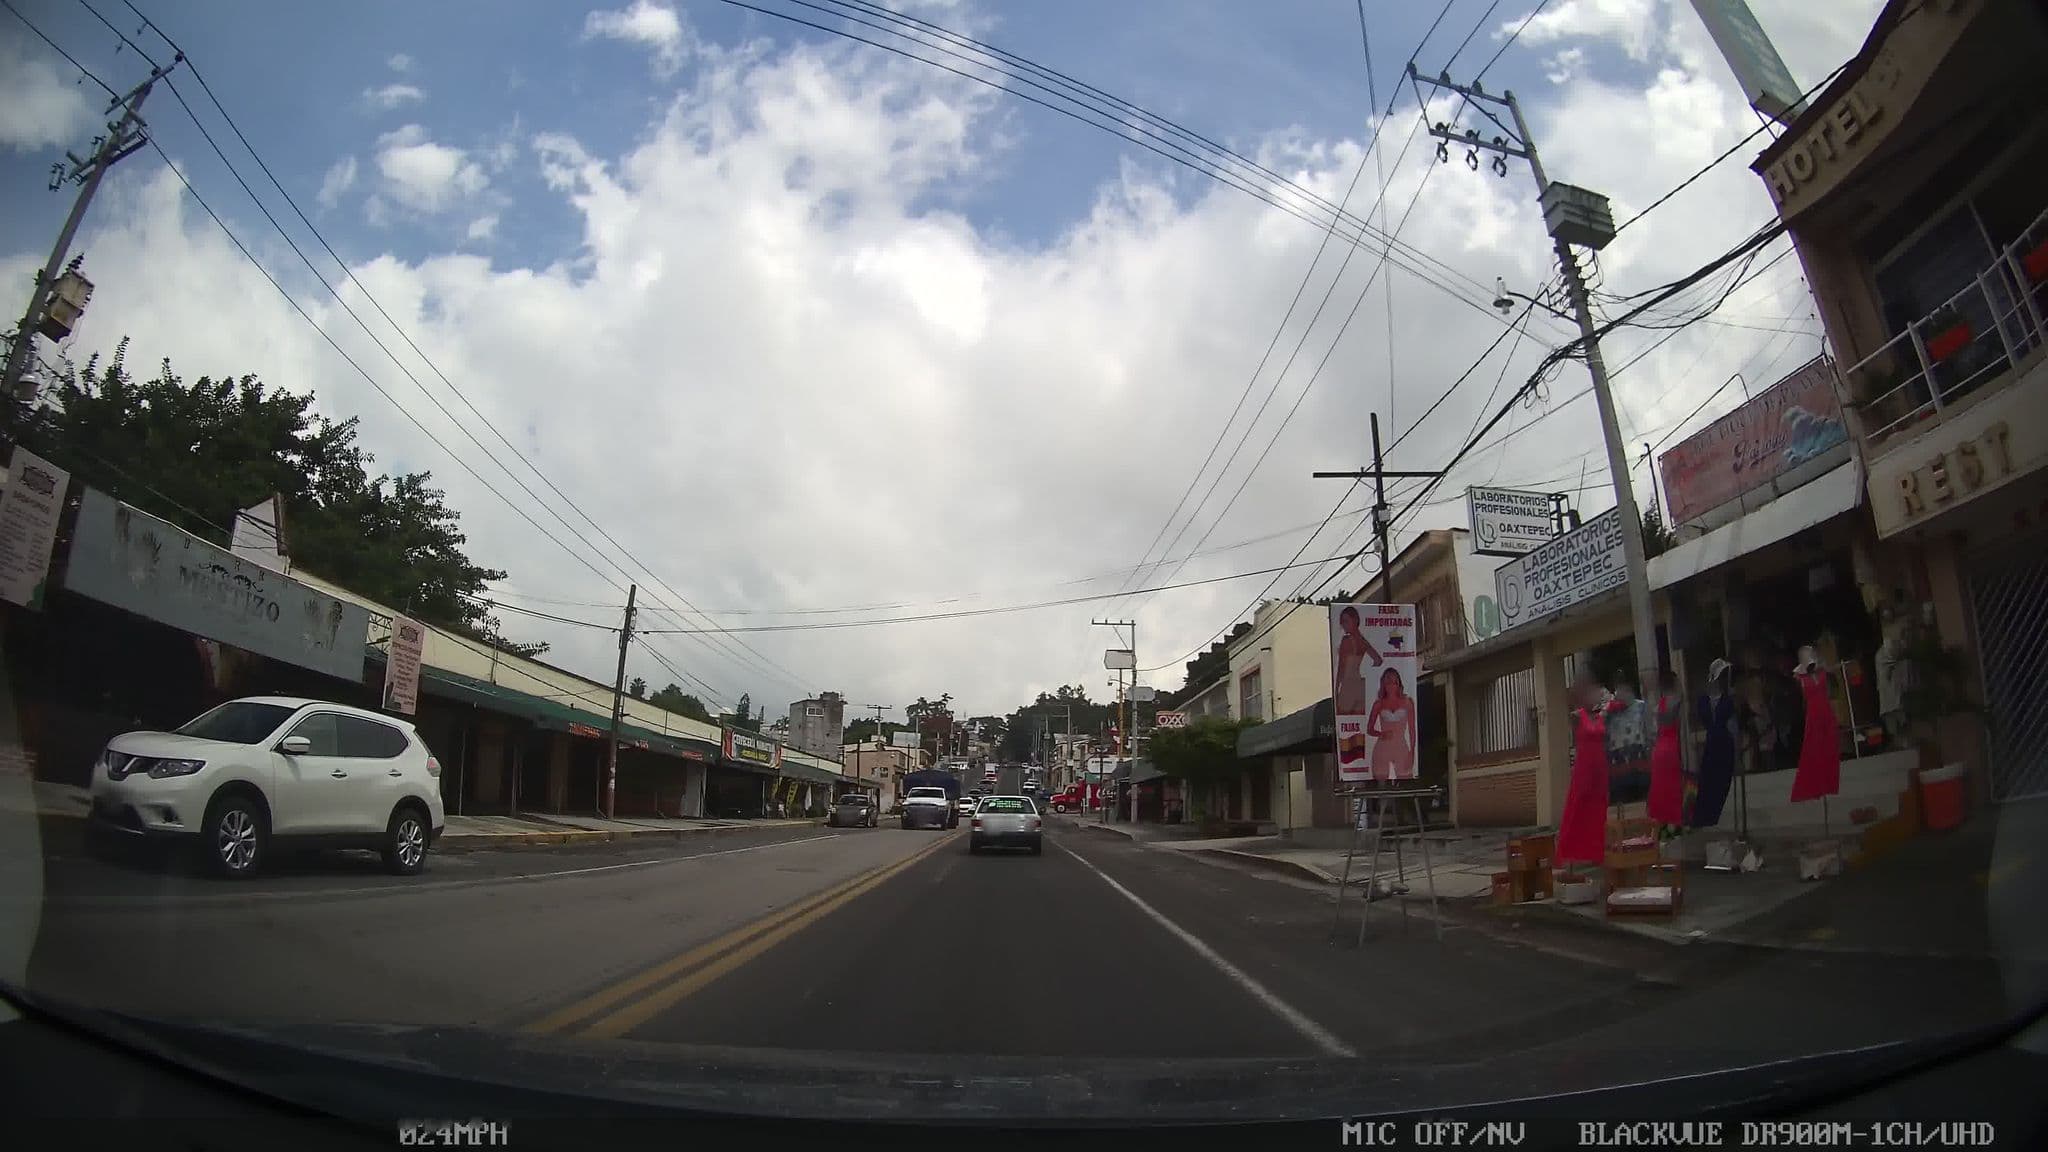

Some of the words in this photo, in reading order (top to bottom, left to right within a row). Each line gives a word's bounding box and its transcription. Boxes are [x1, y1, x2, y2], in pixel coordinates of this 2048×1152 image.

[1768, 92, 1884, 200] HOTEL
[1898, 421, 2012, 516] REST
[1473, 491, 1550, 507] LABORATORIOS
[1474, 503, 1550, 519] PROFESIONALES
[1499, 522, 1551, 537] OAXTEPEC
[1521, 511, 1621, 574] LABORATORIOS
[1524, 529, 1624, 590] PROFESIONALES
[1533, 554, 1613, 601] OAXTEPEC
[1364, 617, 1413, 628] IMPORTADAS
[1340, 722, 1361, 733] FAJAS
